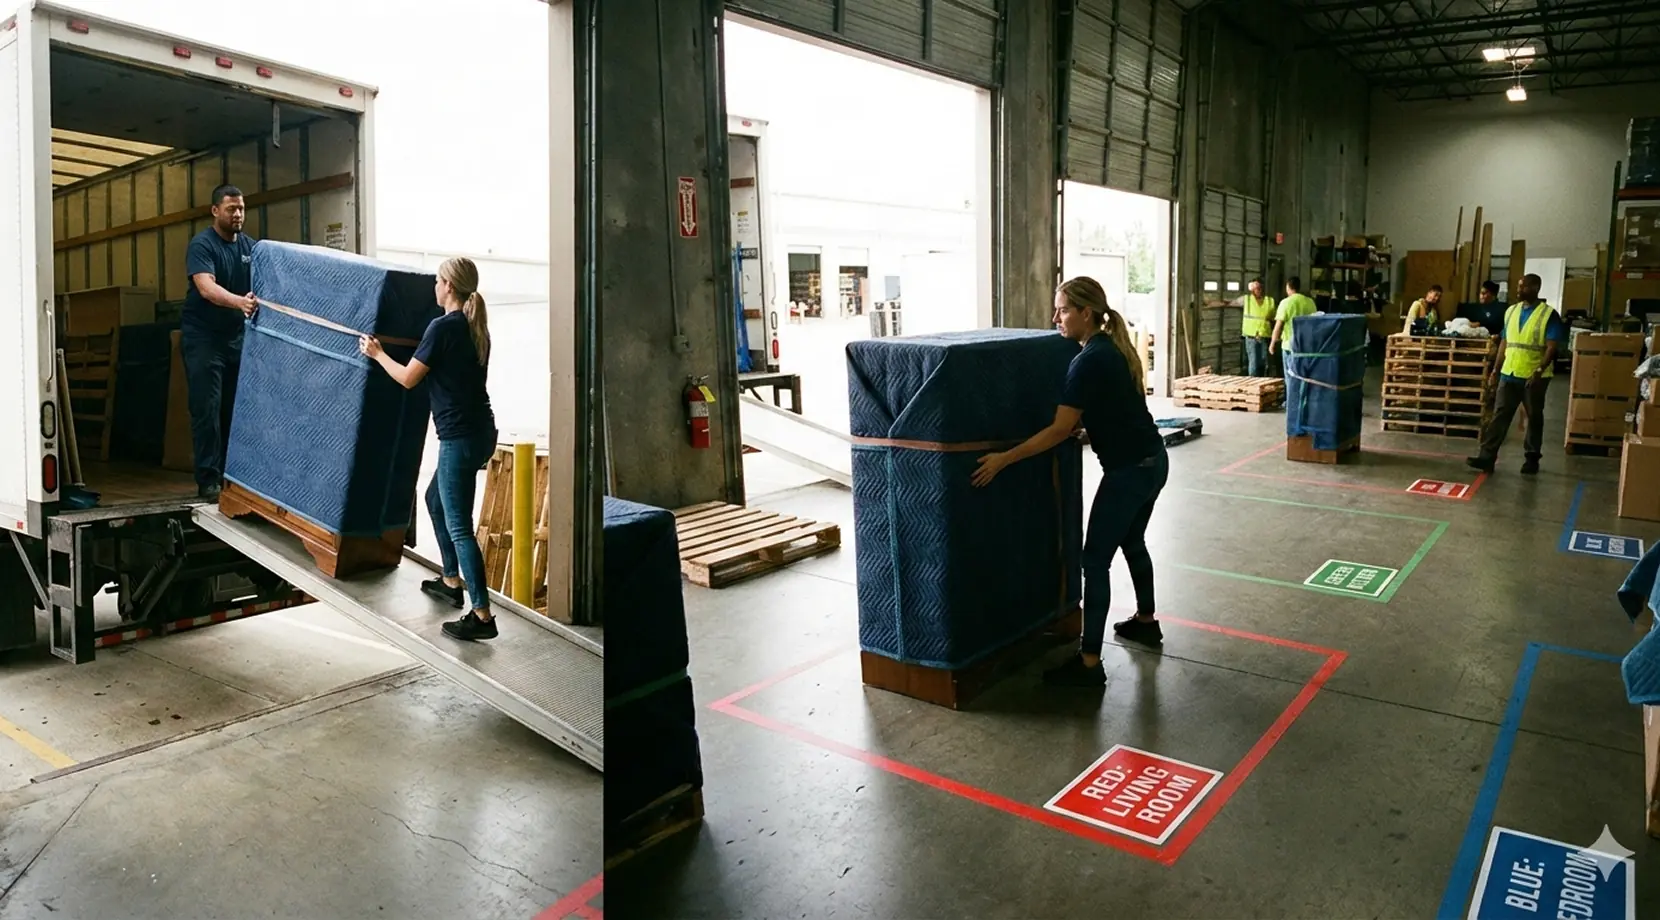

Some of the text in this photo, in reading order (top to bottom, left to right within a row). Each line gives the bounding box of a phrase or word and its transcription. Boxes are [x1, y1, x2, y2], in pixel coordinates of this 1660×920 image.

[1081, 765, 1133, 800] RED:
[1102, 766, 1169, 818] LIVING
[1135, 774, 1198, 824] ROOM
[1504, 857, 1546, 912] BLUE:
